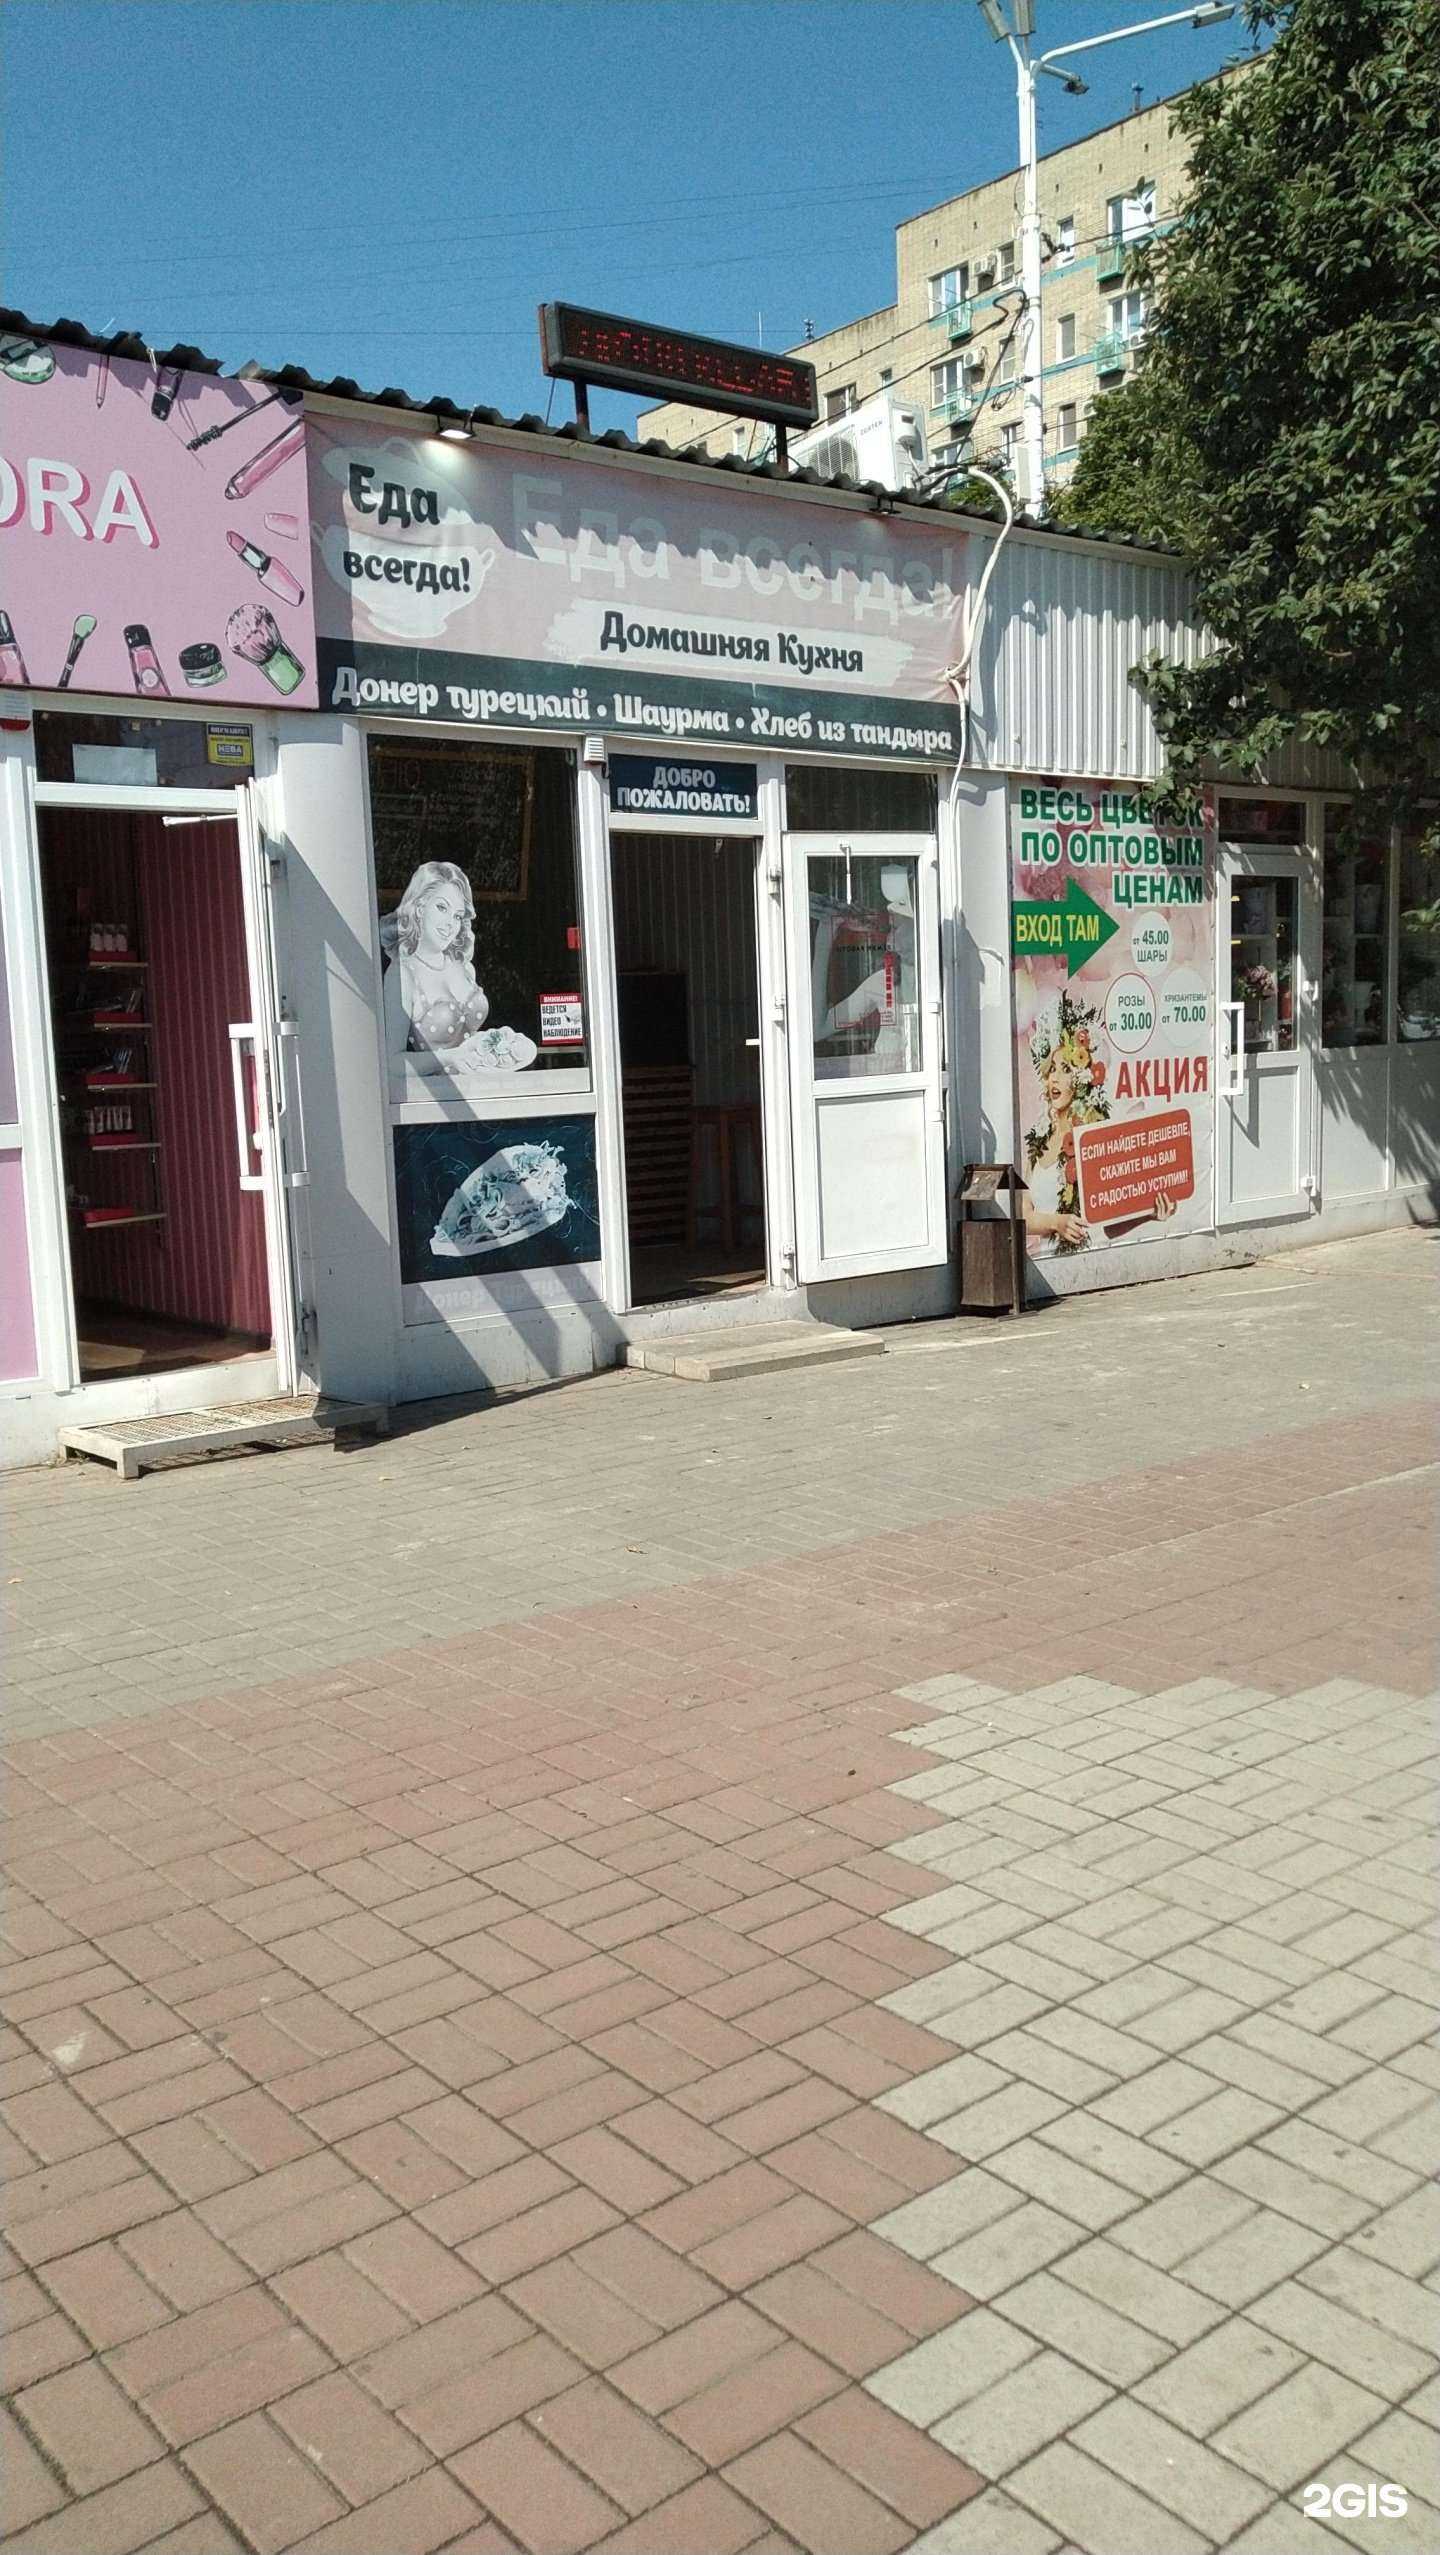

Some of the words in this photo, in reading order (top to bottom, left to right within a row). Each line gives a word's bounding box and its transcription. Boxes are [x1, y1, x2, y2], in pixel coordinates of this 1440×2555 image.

[0, 457, 160, 549] RA
[349, 463, 440, 528] Еда
[513, 472, 671, 588] Еда
[343, 551, 470, 595] всегда!
[601, 611, 770, 662] Домашняя
[777, 633, 863, 675] Кухня
[332, 667, 439, 714] Донер
[446, 688, 591, 721] турецкий
[614, 693, 730, 735] Шаурма
[751, 707, 812, 738] Хлеб
[818, 720, 846, 742] из
[850, 722, 952, 755] тандыра
[652, 766, 716, 789] ДОБРО
[617, 787, 750, 813] ПОЖАЛОВАТЬ!
[1020, 789, 1093, 824] ВЕСЬ
[1021, 832, 1060, 863] ПО
[1069, 834, 1203, 866] ОПТОВЫМ
[1114, 875, 1203, 909] ЦЕНАМ
[1016, 914, 1063, 947] ВХОД
[1067, 915, 1100, 942] ТАМ
[1142, 930, 1169, 945] 45.00
[1137, 950, 1168, 963] ШАРЫ
[542, 1004, 567, 1014] ВЕДЕТСЯ
[543, 995, 578, 1003] ВНИМАНИЕ!
[1118, 995, 1146, 1007] РОЗЫ
[1161, 1014, 1170, 1024] от
[1174, 1006, 1206, 1022] 70.00
[543, 1017, 562, 1026] ВИДЕО
[544, 1028, 582, 1037] НАБЛЮДЕНИЕ
[1109, 1022, 1117, 1032] от
[1120, 1012, 1152, 1030] 30.00
[1115, 1056, 1208, 1102] АКЦИЯ
[1081, 1142, 1105, 1161] ЕСЛИ
[1107, 1131, 1146, 1155] НАЙДЕТЕ
[1148, 1121, 1191, 1146] ДЕШЕВЛЕ,
[1099, 1157, 1141, 1181] СКАЖИТЕ
[1142, 1154, 1158, 1170] МЫ
[1159, 1149, 1177, 1166] ВАМ
[1089, 1194, 1097, 1208] С
[1098, 1181, 1147, 1207] РАДОСТЬЮ
[1148, 1169, 1188, 1193] УСТУПИМ!
